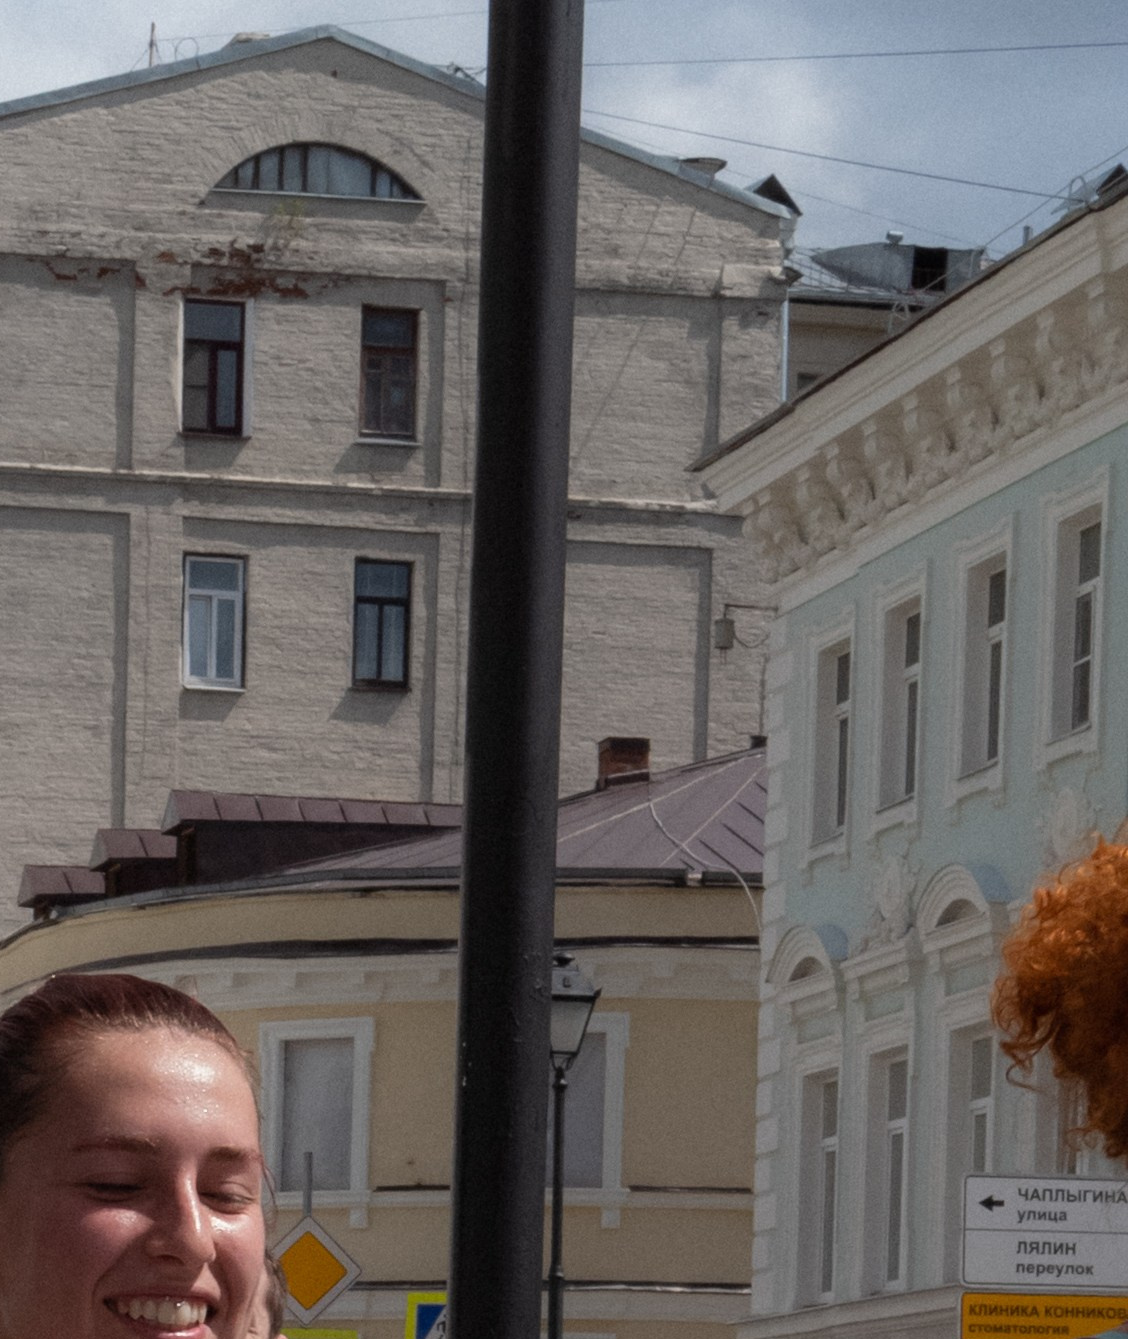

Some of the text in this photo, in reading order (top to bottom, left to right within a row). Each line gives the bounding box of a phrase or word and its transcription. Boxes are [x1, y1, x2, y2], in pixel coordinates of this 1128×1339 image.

[1017, 1187, 1128, 1204] ЧАПЛЫГИНА
[1017, 1210, 1068, 1224] улица
[1016, 1241, 1077, 1256] ЛЯЛИН
[1016, 1263, 1094, 1278] переулок
[968, 1304, 1040, 1318] КЛИНИКА
[968, 1323, 1070, 1336] стоматология
